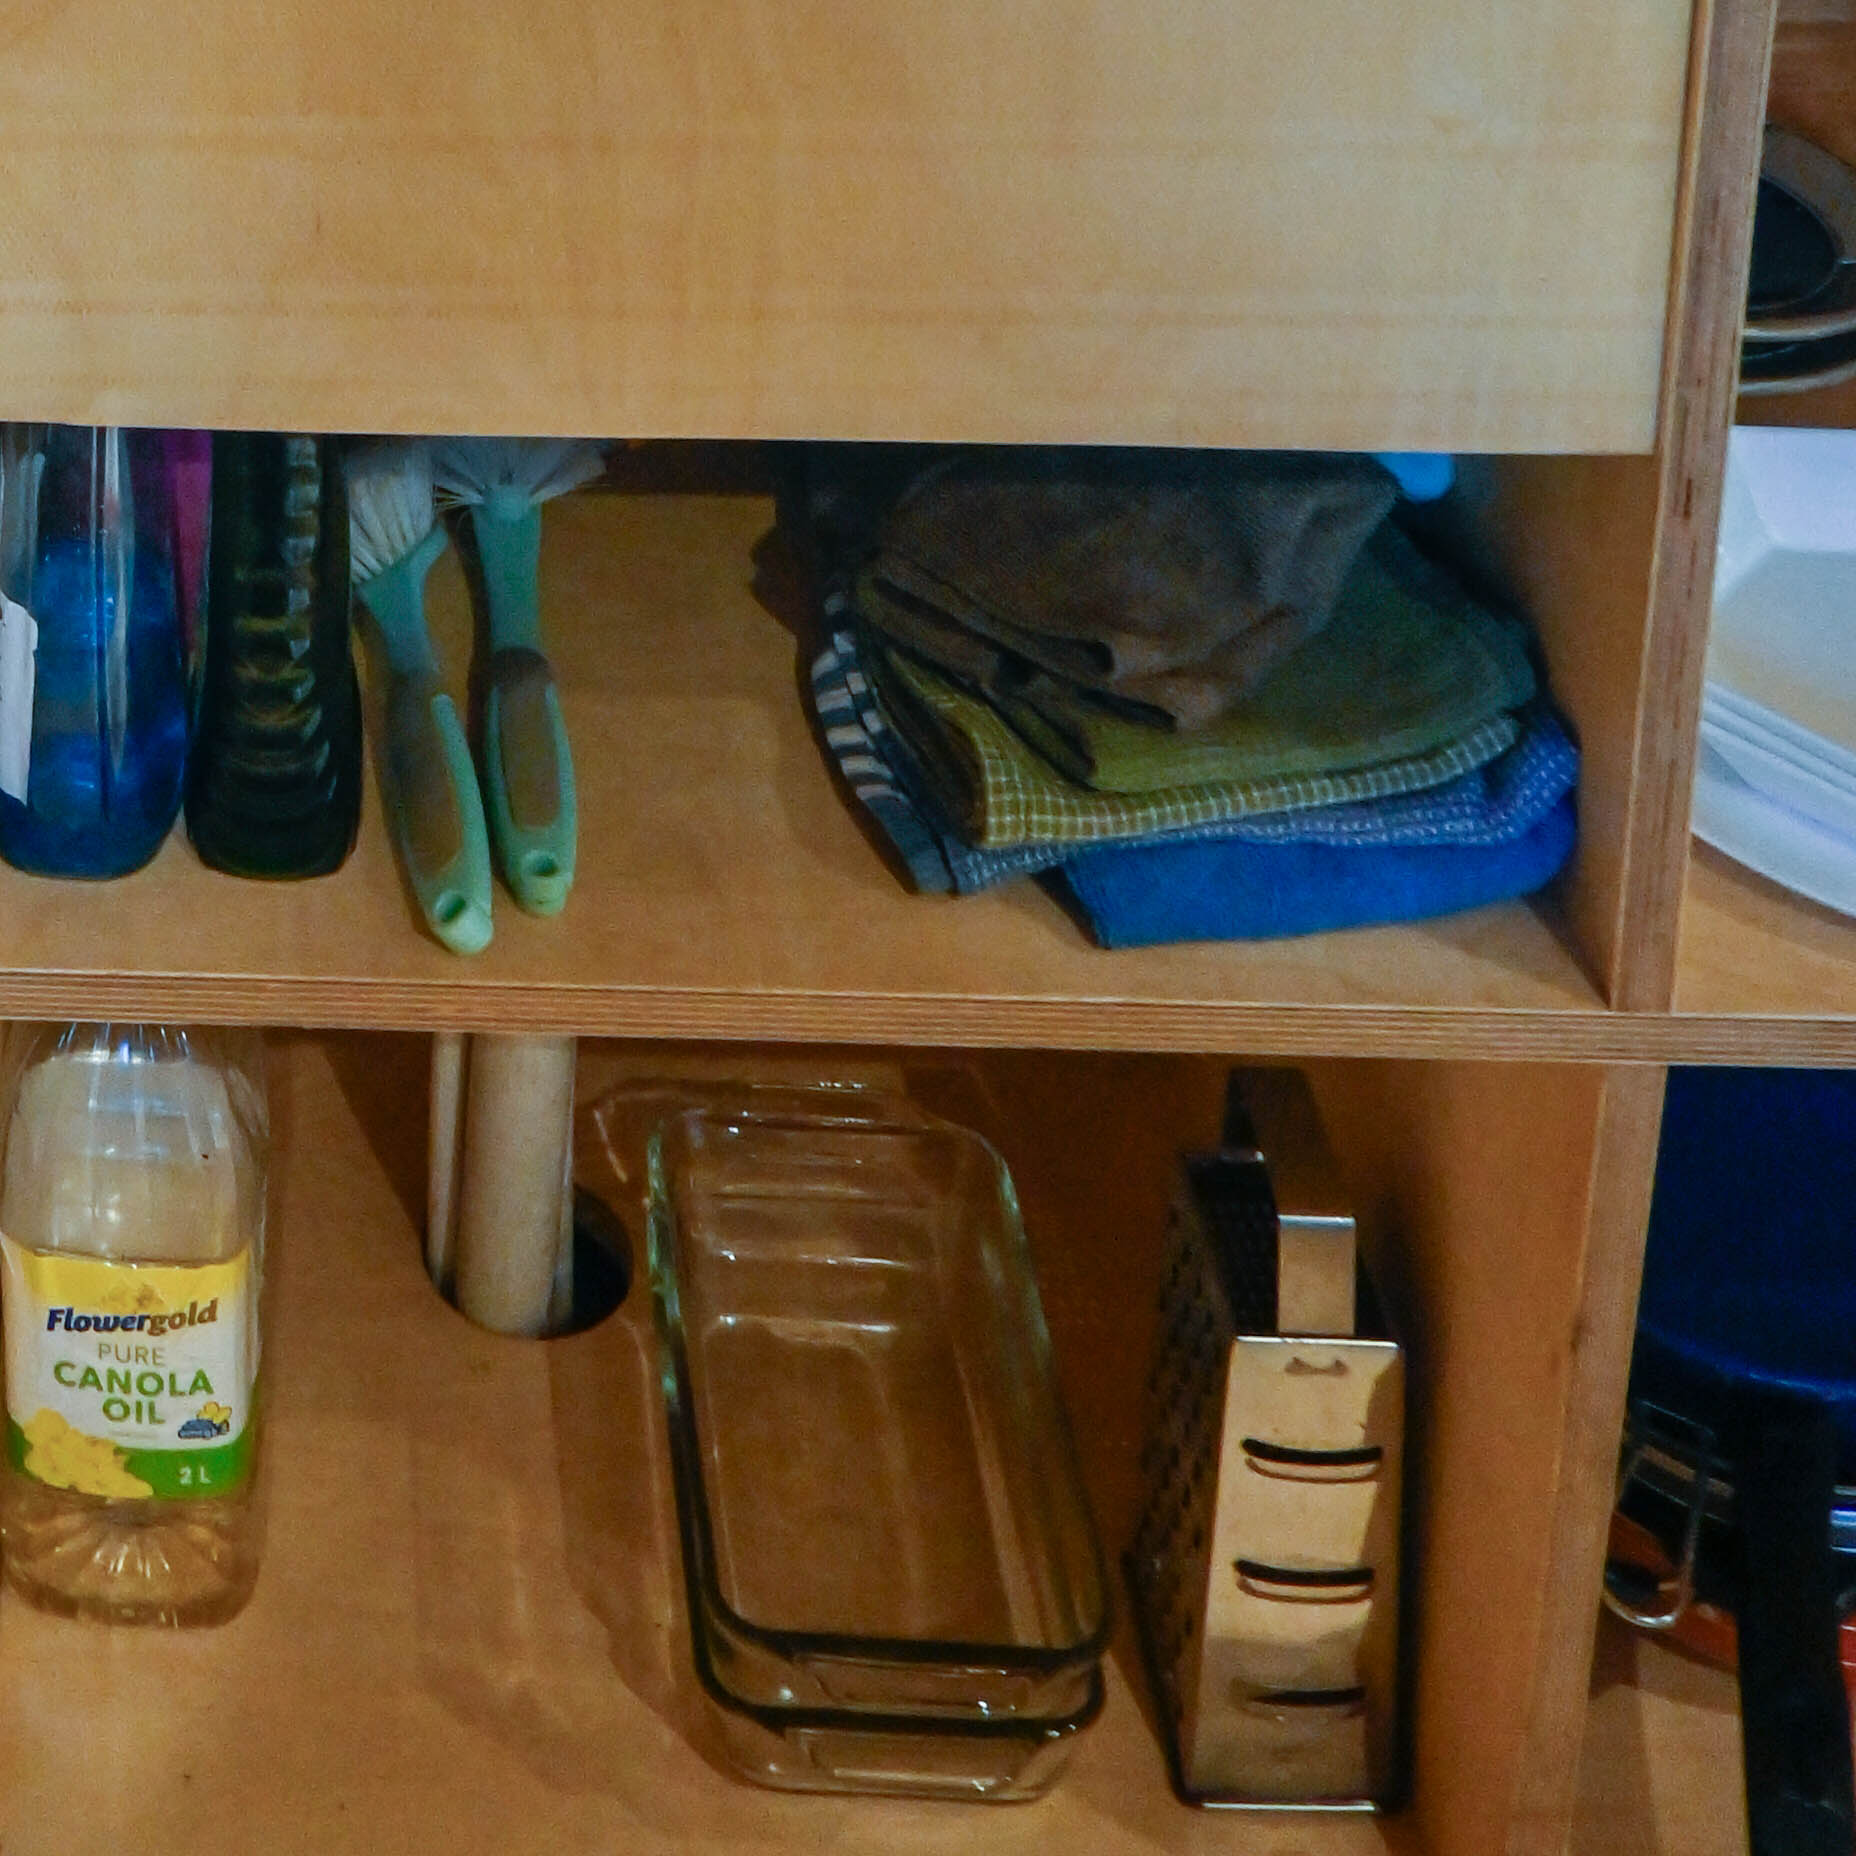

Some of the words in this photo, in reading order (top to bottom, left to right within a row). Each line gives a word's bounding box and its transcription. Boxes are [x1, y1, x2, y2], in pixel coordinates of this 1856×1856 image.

[46, 1297, 219, 1336] Flowergold
[98, 1343, 166, 1366] PURE
[53, 1361, 215, 1397] CANOLA
[102, 1398, 166, 1425] OIL
[199, 1466, 212, 1484] L
